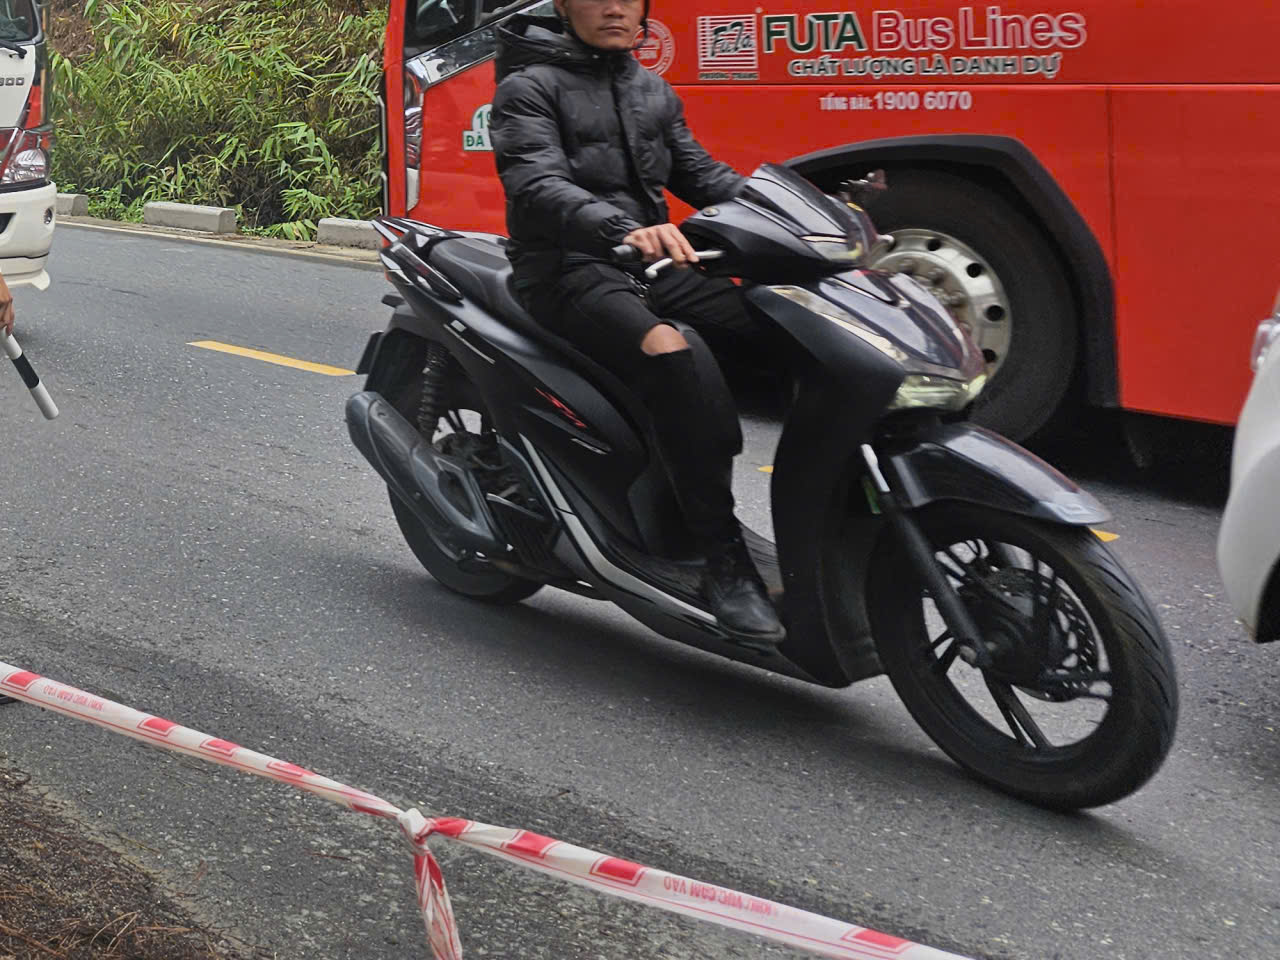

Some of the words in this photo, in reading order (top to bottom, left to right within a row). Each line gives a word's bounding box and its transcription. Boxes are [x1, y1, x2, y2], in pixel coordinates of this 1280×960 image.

[762, 11, 868, 55] FUTA
[872, 10, 954, 52] Bus
[959, 5, 1087, 50] Lines
[842, 56, 917, 79] LƯỢNG
[919, 53, 950, 75] LÀ
[951, 55, 1018, 75] DANH
[1022, 51, 1063, 79] DỰ
[874, 91, 920, 110] 1900
[923, 91, 972, 110] 6070
[466, 131, 485, 147] ĐÀ
